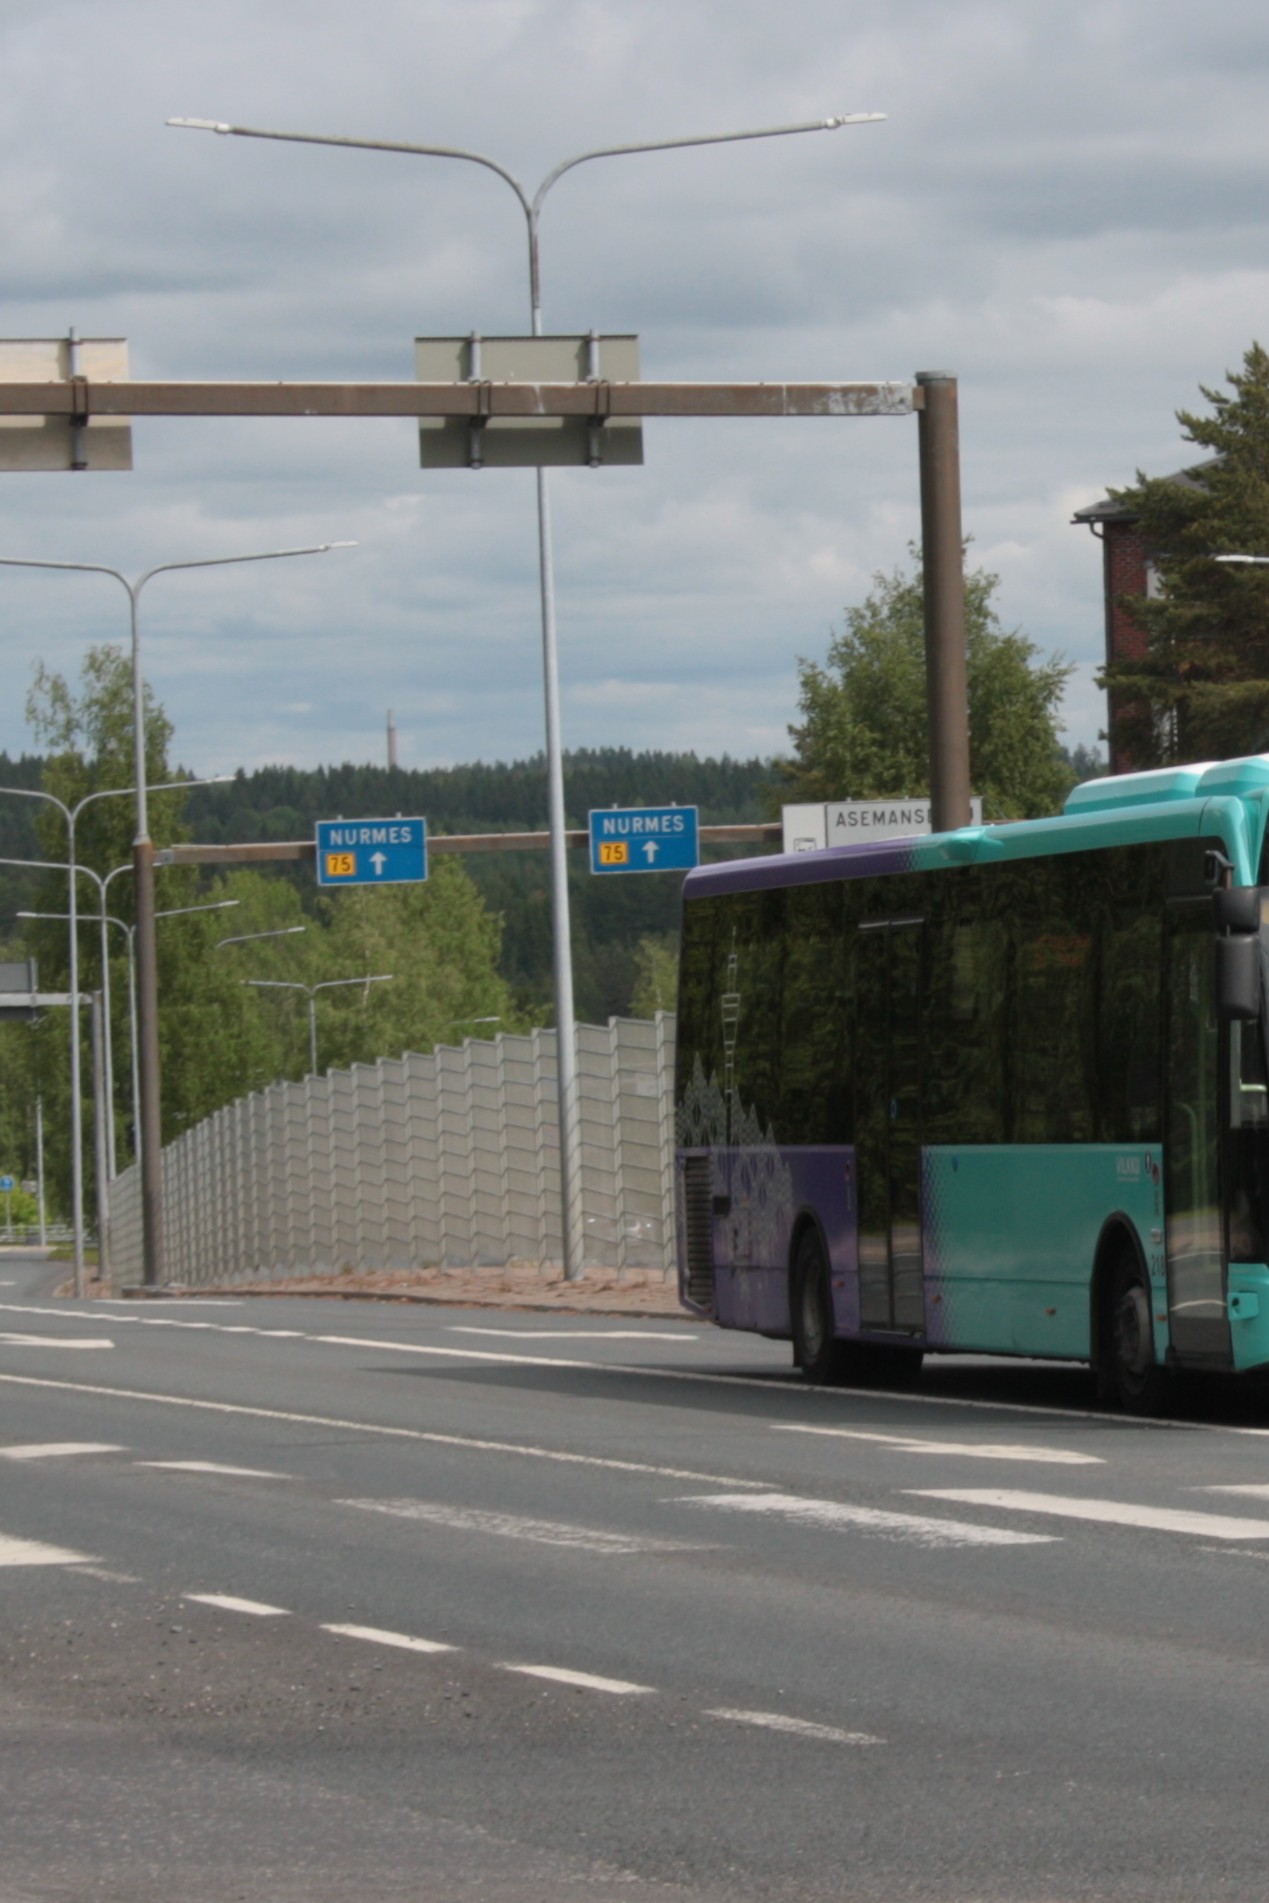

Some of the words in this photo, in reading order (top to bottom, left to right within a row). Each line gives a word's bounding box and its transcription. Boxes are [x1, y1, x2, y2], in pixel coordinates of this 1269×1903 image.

[603, 814, 684, 834] NURMES
[836, 808, 974, 827] ASEMANS
[330, 826, 412, 846] NURMES
[603, 844, 624, 862] 75
[330, 856, 351, 873] 75
